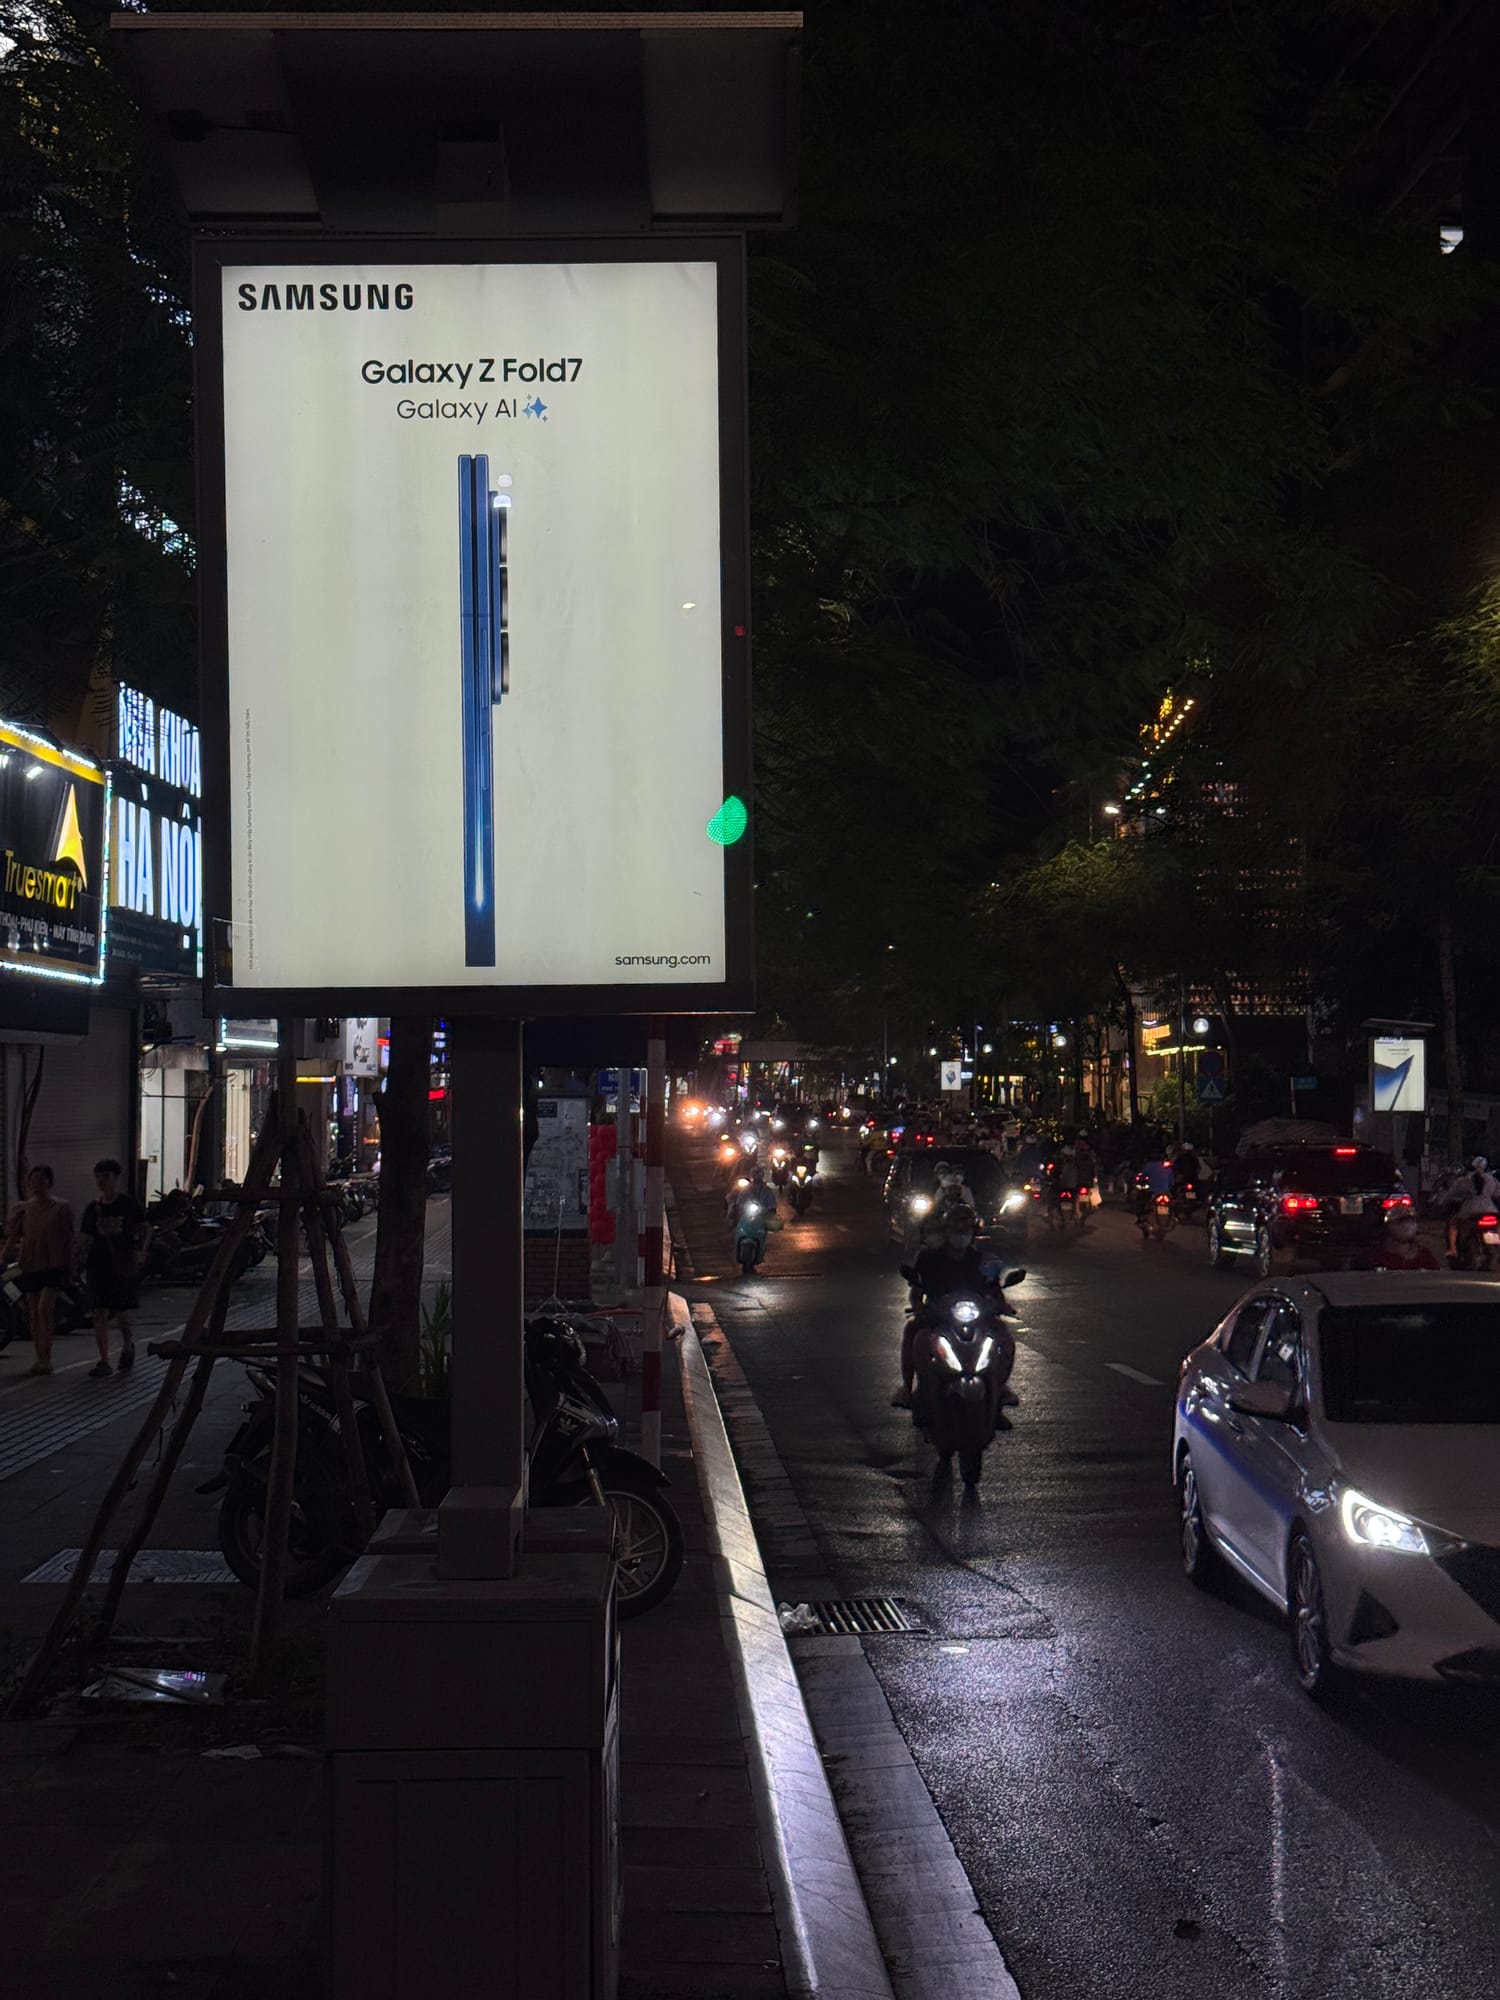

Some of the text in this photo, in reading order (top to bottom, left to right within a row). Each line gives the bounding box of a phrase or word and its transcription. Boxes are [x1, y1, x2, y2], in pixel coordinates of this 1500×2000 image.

[238, 283, 414, 312] SAMSUNG
[361, 357, 583, 390] Galaxy Z Fold7
[396, 398, 517, 426] Galaxy AI
[160, 708, 201, 798] KHOA
[5, 850, 76, 910] Truesmart
[117, 783, 154, 916] HÀ
[160, 802, 202, 949] NỘI
[615, 955, 711, 969] samsung.com
